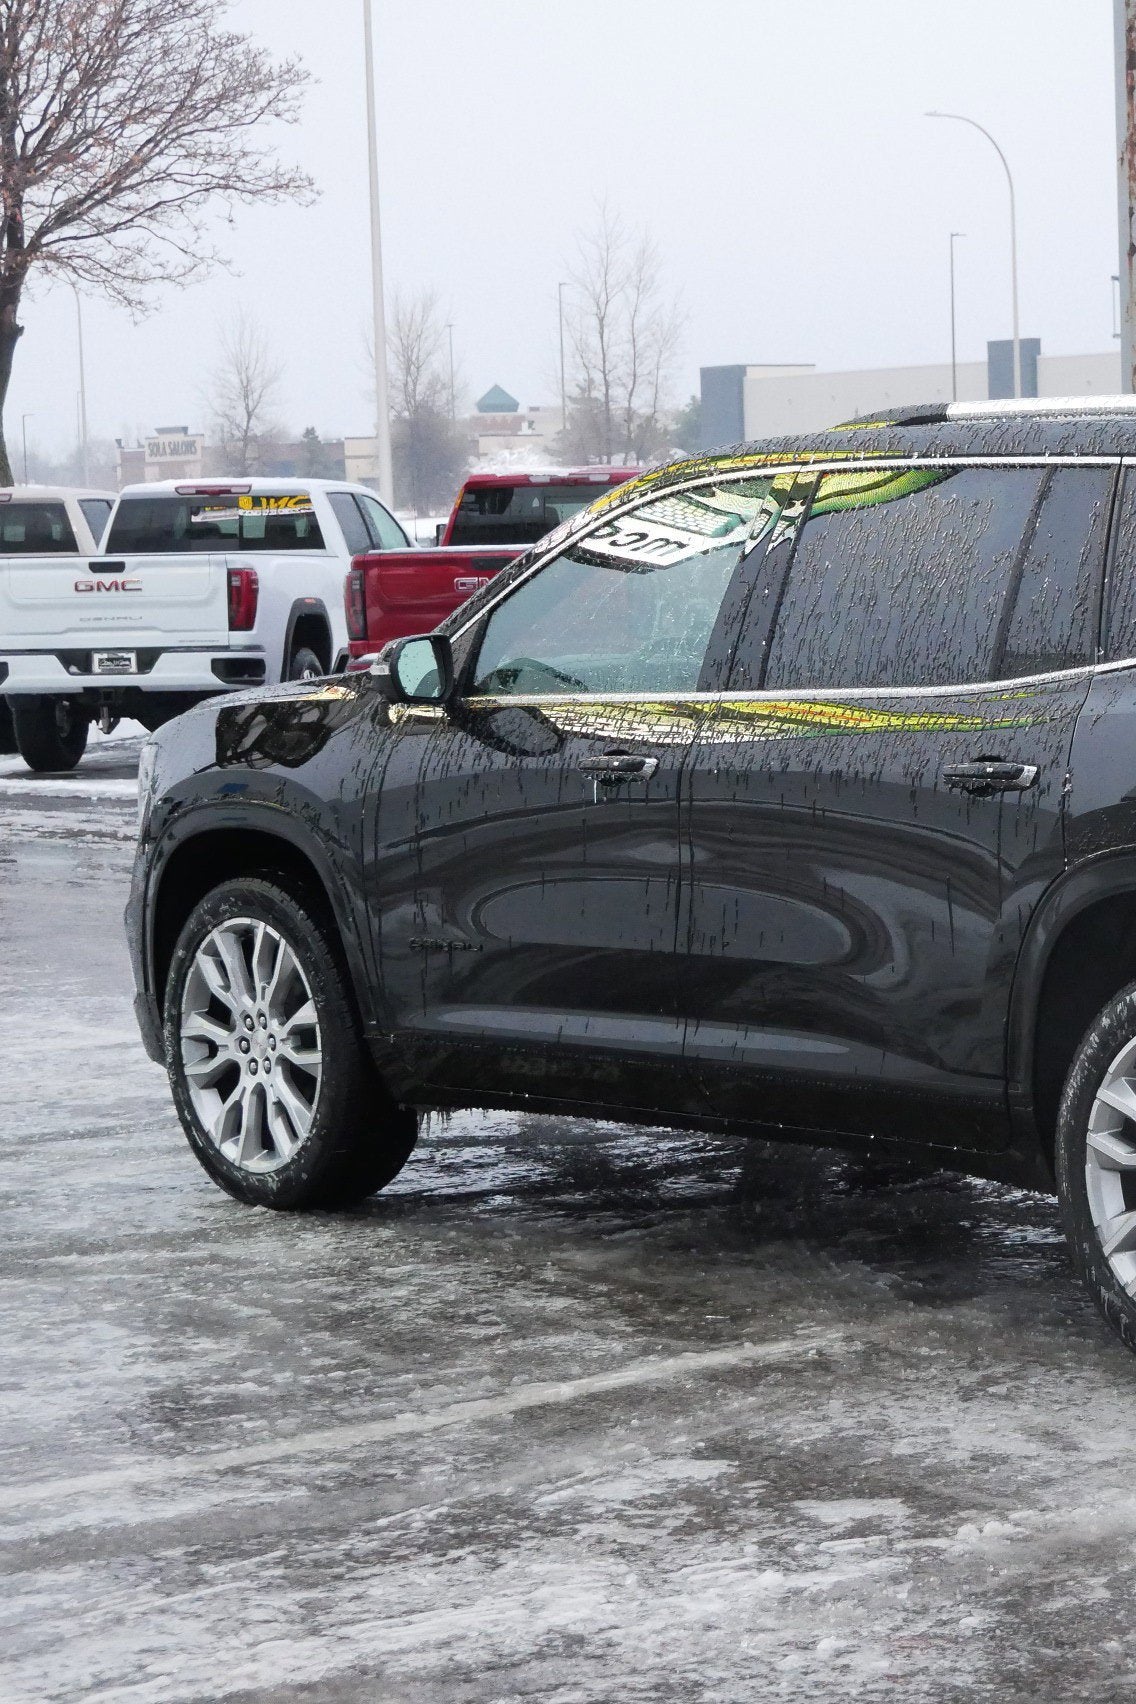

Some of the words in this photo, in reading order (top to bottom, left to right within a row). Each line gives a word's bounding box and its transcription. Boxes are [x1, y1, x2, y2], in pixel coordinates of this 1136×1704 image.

[148, 441, 167, 457] SOLA
[168, 440, 197, 457] SALONS
[74, 579, 143, 593] GMC
